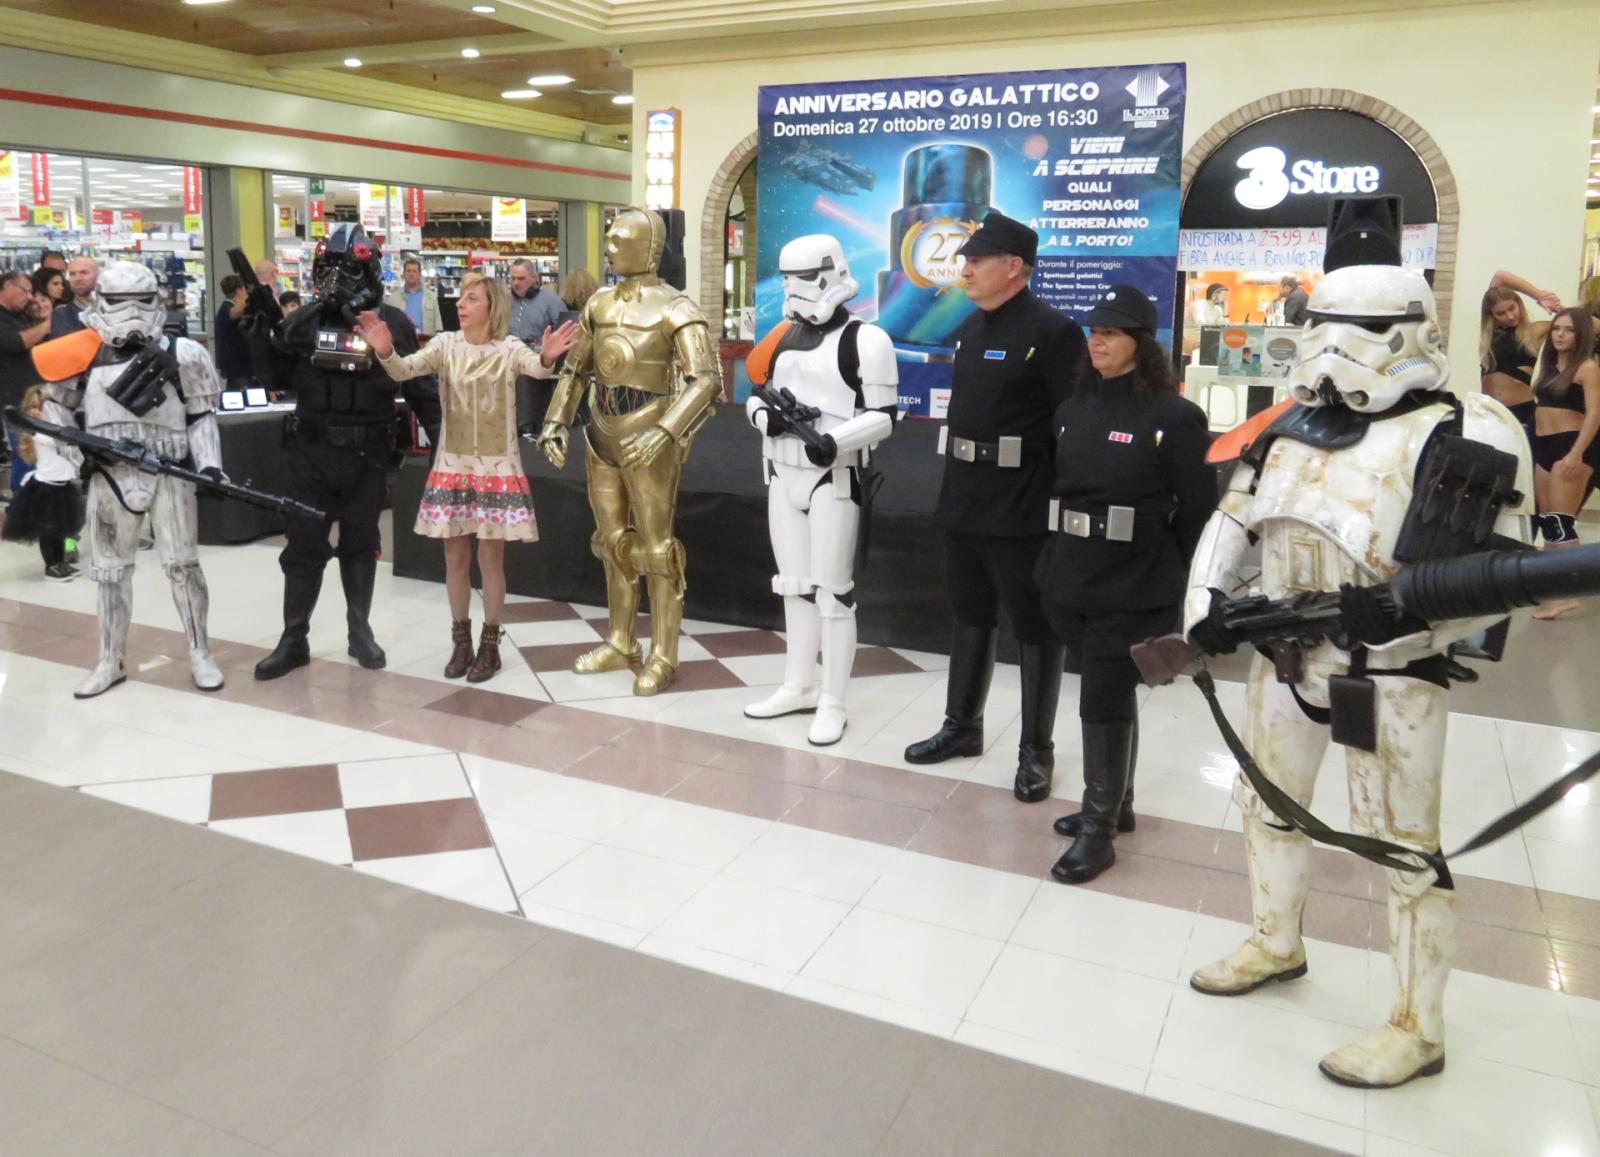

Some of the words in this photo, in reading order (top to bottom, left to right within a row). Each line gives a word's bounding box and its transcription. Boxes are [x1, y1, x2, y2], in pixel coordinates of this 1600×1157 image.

[773, 89, 944, 115] ANNIVERSARIO
[949, 81, 1100, 107] GALATTICO
[1134, 107, 1170, 117] PORTO
[773, 119, 854, 137] Domenica
[858, 118, 880, 134] 27
[882, 115, 946, 133] ottobre
[949, 113, 993, 130] 2019
[1007, 111, 1042, 129] Ore
[1047, 108, 1099, 127] 16:30
[1070, 136, 1126, 155] VIENI
[1032, 159, 1049, 177] A
[1053, 156, 1160, 177] SCOPRIRE
[1290, 159, 1380, 194] Store
[1066, 181, 1112, 194] QUALI
[1042, 199, 1140, 212] PERSONAGGI
[1028, 216, 1150, 230] ATTERRERANNO
[1046, 235, 1058, 247] A
[1060, 235, 1073, 247] IL
[1075, 234, 1135, 247] PORTO!
[1037, 259, 1068, 269] Durante
